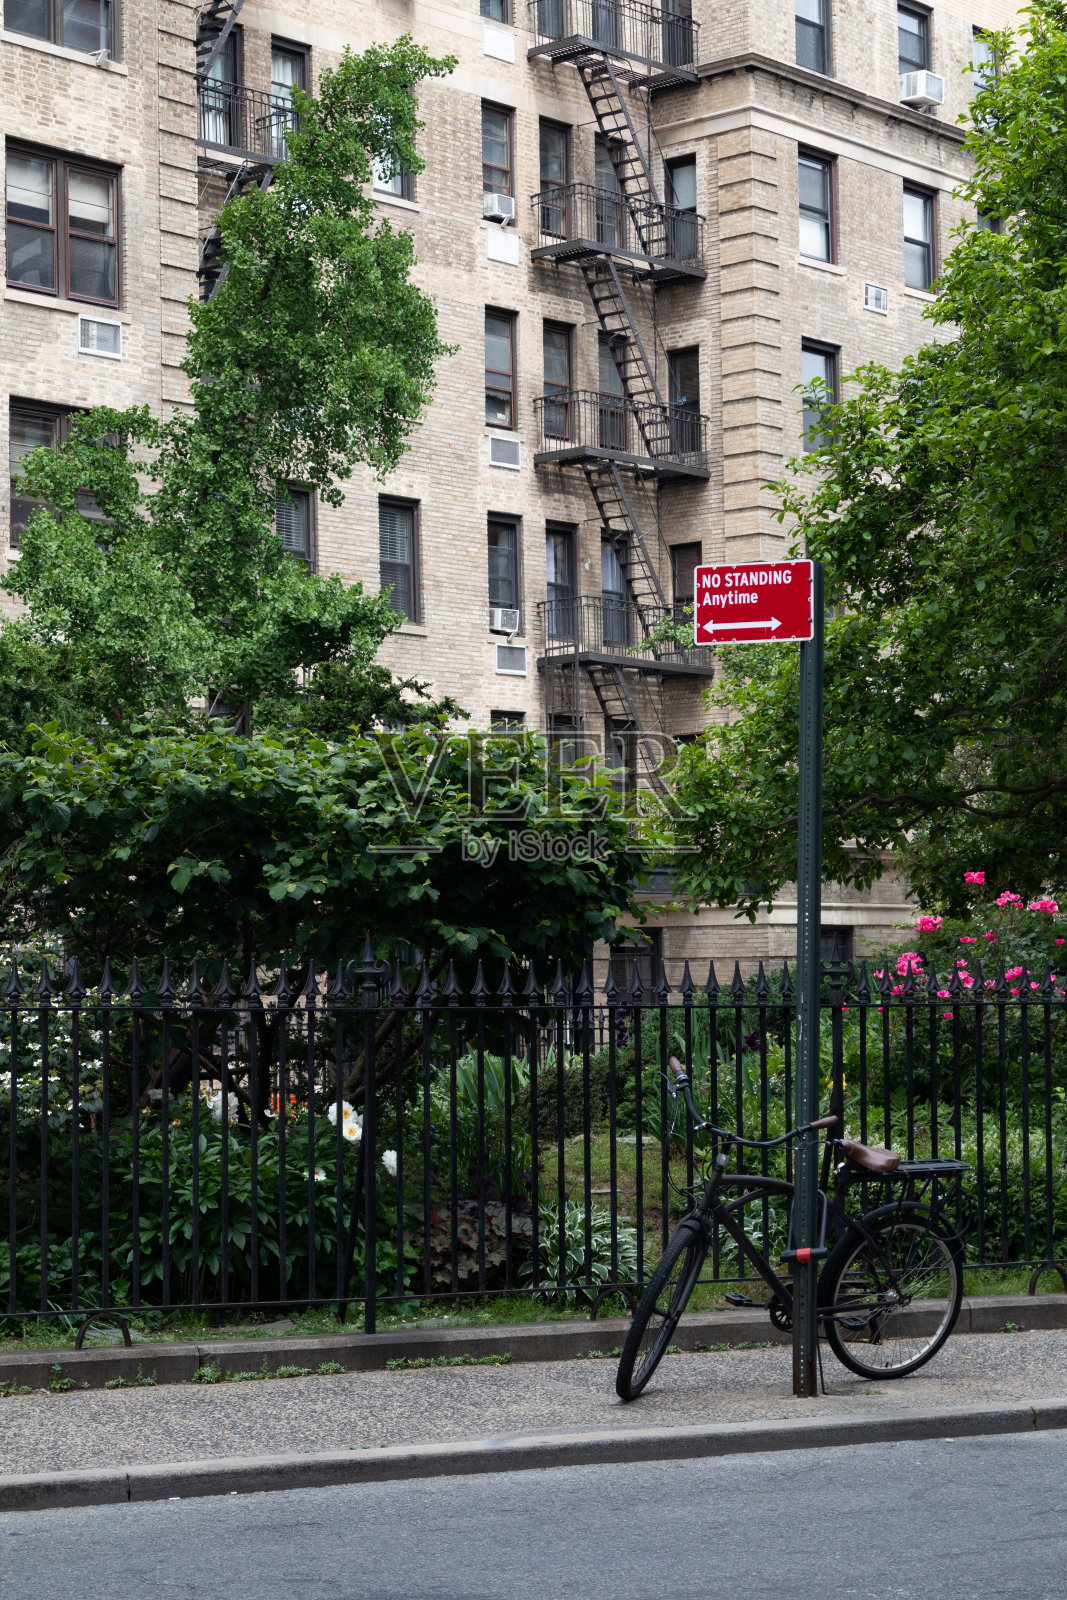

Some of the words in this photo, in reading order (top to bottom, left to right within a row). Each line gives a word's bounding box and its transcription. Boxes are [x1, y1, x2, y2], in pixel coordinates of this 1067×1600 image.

[702, 573, 721, 589] NO
[724, 569, 792, 588] STANDING
[702, 590, 759, 609] Anytime
